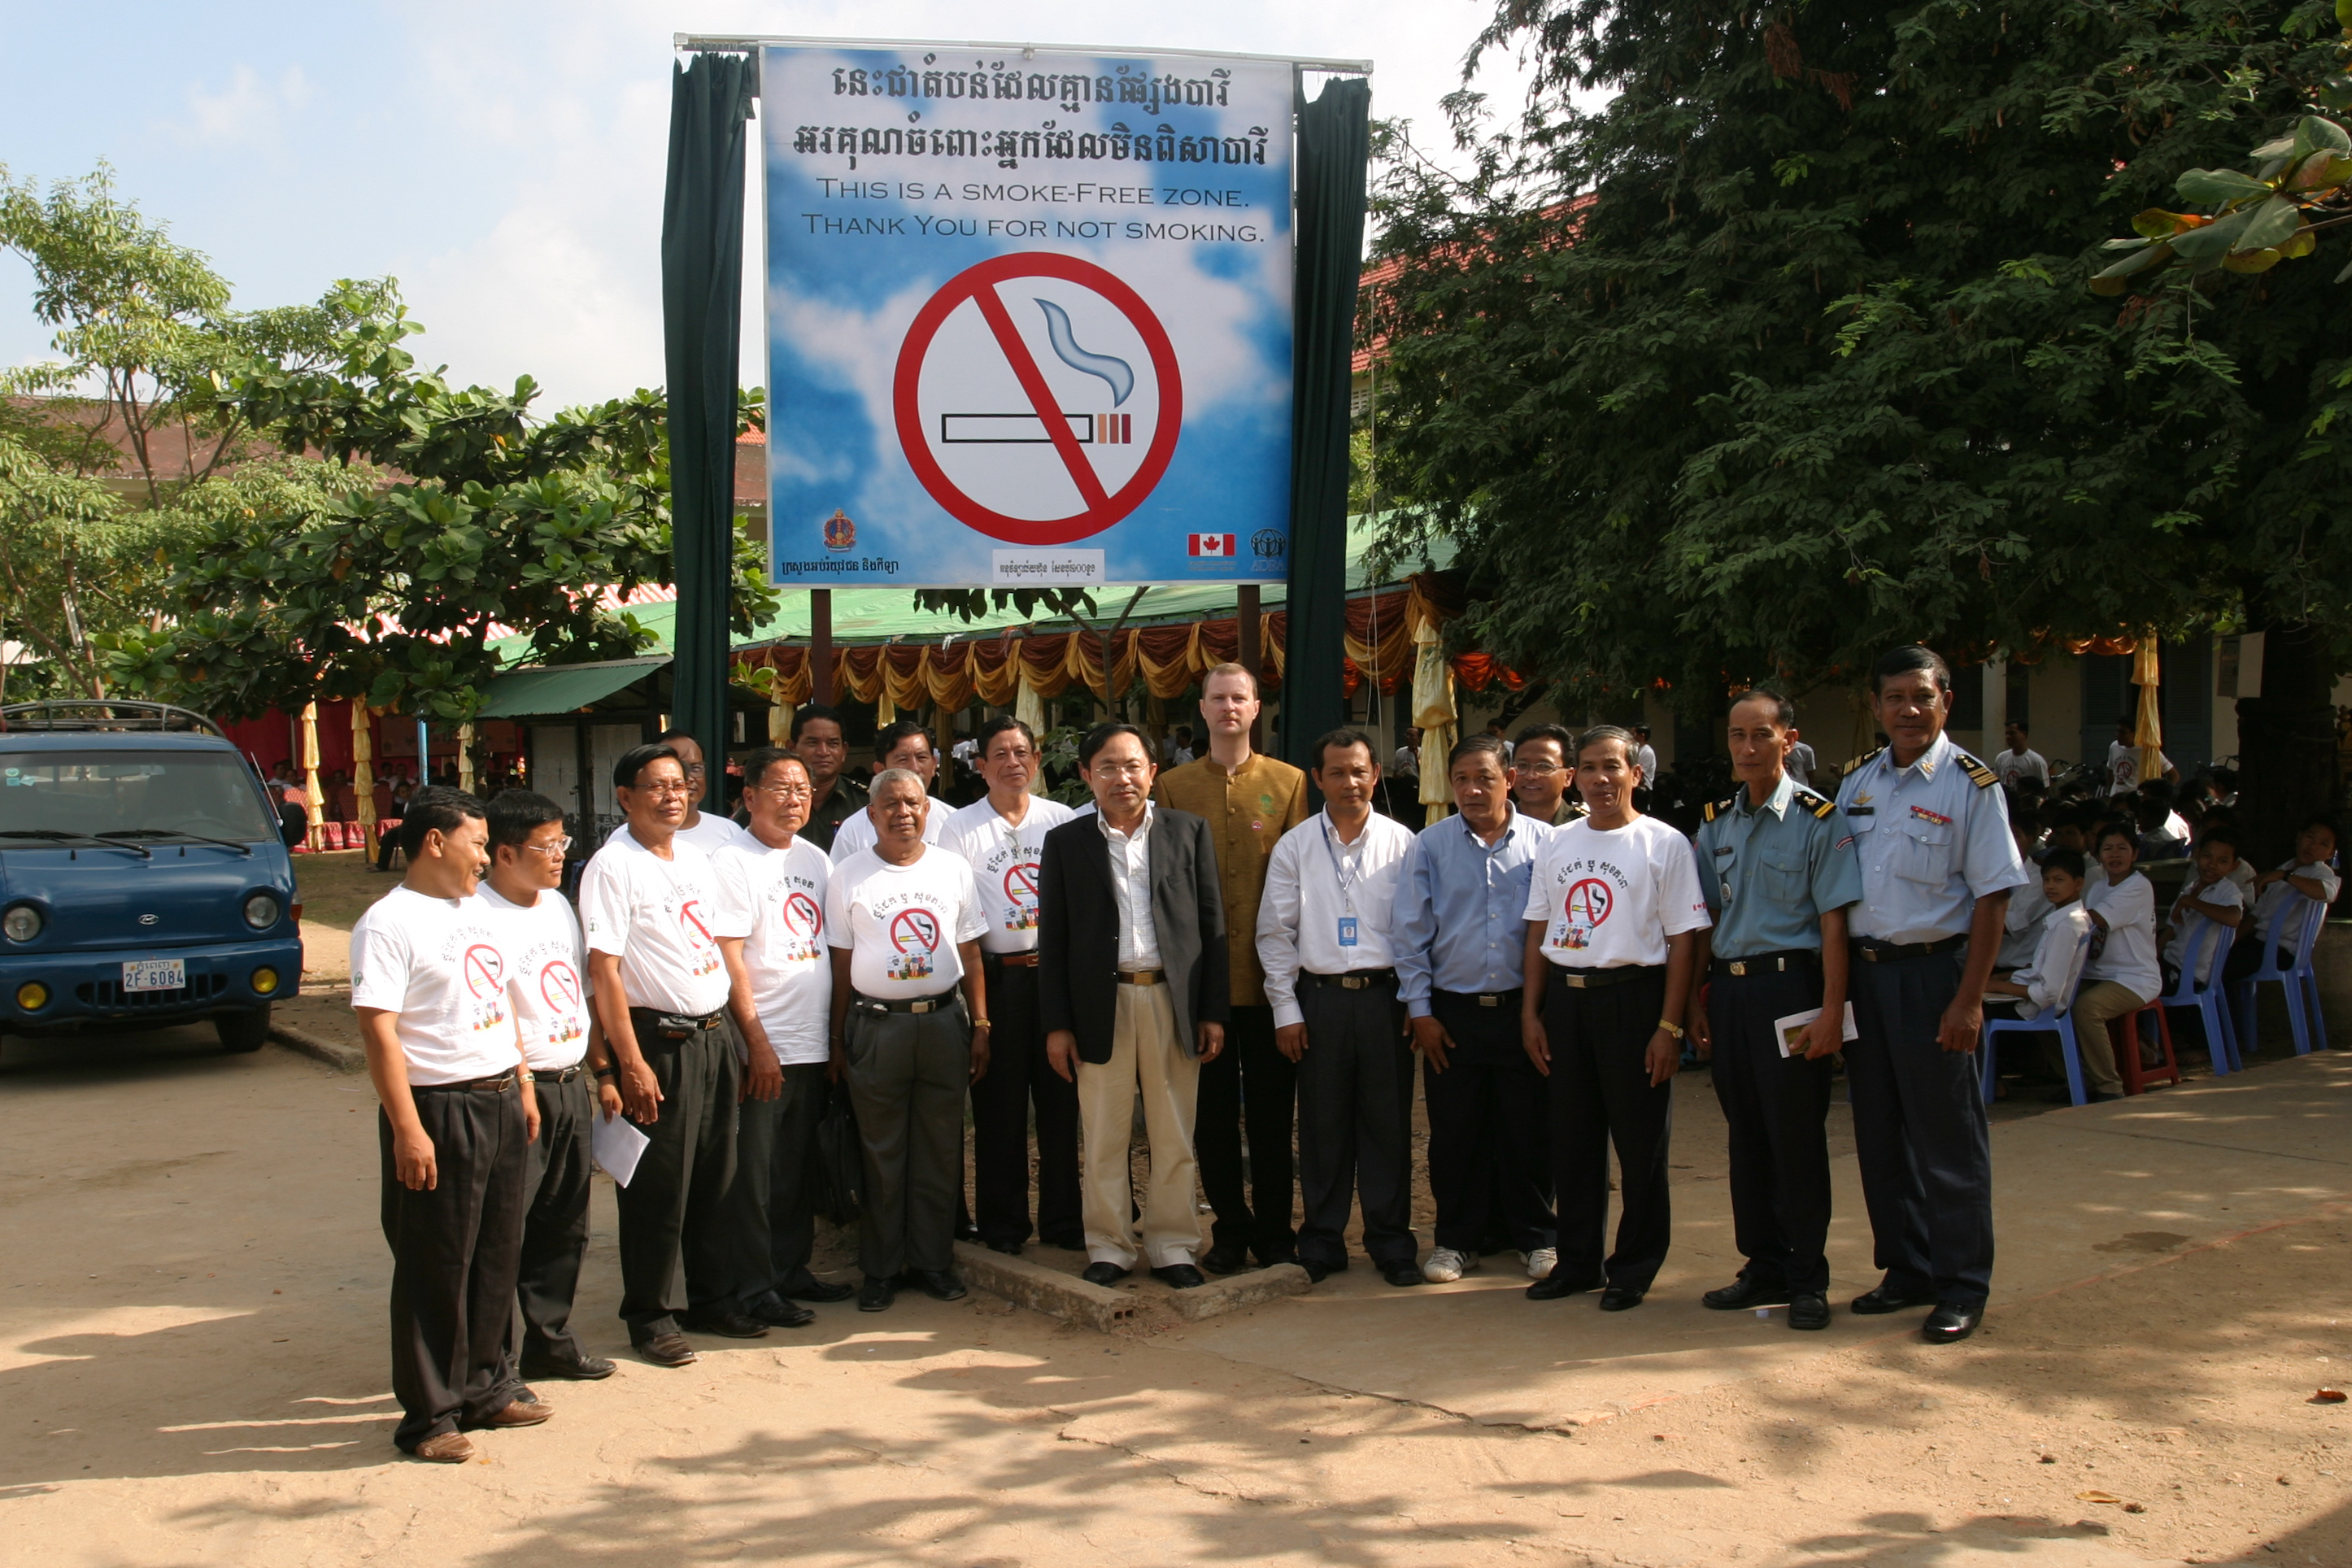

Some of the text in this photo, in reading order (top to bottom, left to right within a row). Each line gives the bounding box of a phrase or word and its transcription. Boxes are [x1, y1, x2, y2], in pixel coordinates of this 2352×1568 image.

[816, 177, 1249, 207] THIS IS A SMOKE-FREE ZONE.
[801, 213, 1265, 242] THANK YOU FOR NOT SMOKING.
[1250, 560, 1287, 571] ADRA
[125, 970, 184, 987] 2F-6084
